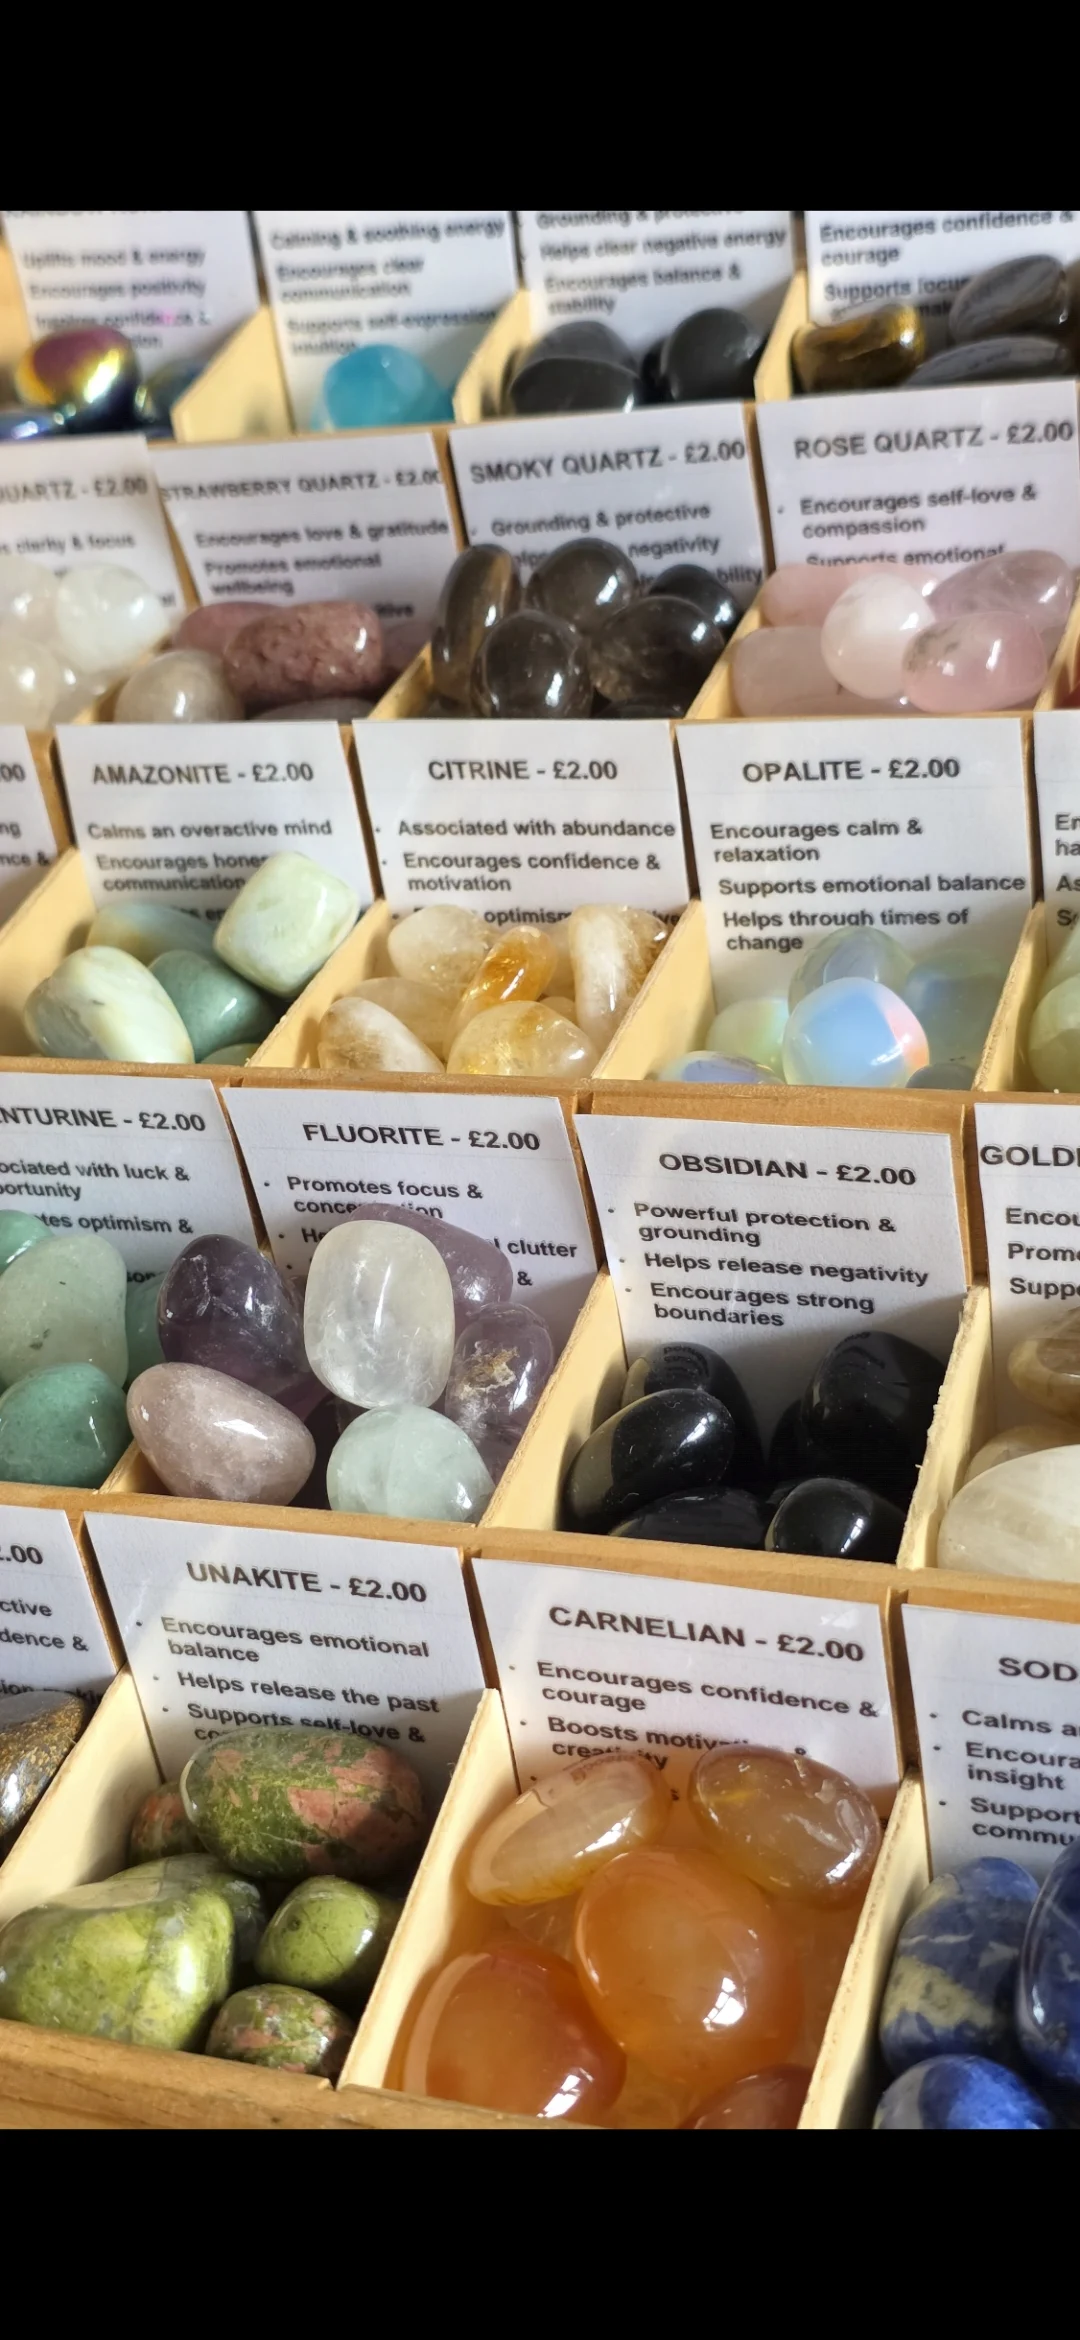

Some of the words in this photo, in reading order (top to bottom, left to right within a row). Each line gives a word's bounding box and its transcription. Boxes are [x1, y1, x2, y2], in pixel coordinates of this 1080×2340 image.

[819, 219, 935, 243] Encourages
[539, 241, 591, 262] Helps
[595, 238, 637, 257] clear
[642, 233, 718, 257] negative
[723, 228, 787, 249] energy
[821, 247, 901, 267] courage
[276, 261, 377, 282] Encourages
[545, 272, 648, 293] Encourages
[652, 264, 723, 285] balance
[728, 261, 741, 280] &
[29, 282, 126, 301] Encourages
[281, 282, 412, 302] communication
[824, 278, 911, 301] Supports
[548, 296, 616, 316] stability
[794, 435, 866, 460] ROSE
[874, 425, 984, 453] QUARTZ
[1007, 420, 1074, 445] £2.00
[470, 458, 554, 484] SMOKY
[562, 446, 663, 475] QUARTZ
[684, 440, 745, 464] £2.00
[298, 472, 379, 494] QUARTZ
[800, 491, 920, 516] Encourages
[927, 485, 1015, 508] self-love
[1021, 483, 1037, 502] &
[491, 513, 591, 537] Grounding
[596, 511, 609, 528] &
[615, 504, 710, 530] protective
[803, 517, 926, 539] compassion
[196, 529, 301, 549] Encourages
[305, 525, 343, 542] love
[350, 523, 361, 540] &
[368, 519, 448, 543] gratitude
[628, 537, 720, 559] negativity
[205, 559, 289, 577] Promotes
[295, 553, 382, 573] emotional
[211, 579, 294, 597] wellbeing
[92, 763, 232, 786] AMAZONITE
[252, 763, 314, 784] £2.00
[428, 760, 530, 781] CITRINE
[553, 760, 618, 781] £2.00
[742, 760, 864, 783] OPALITE
[888, 758, 961, 780] £2.00
[87, 821, 147, 840] Calms
[153, 823, 175, 838] an
[180, 819, 279, 838] overactive
[284, 818, 333, 837] mind
[398, 819, 508, 837] Associated
[514, 818, 556, 837] with
[562, 819, 676, 838] abundance
[710, 822, 840, 842] Encourages
[846, 820, 899, 837] calm
[907, 819, 923, 836] &
[97, 853, 209, 872] Encourages
[403, 853, 522, 873] Encourages
[528, 853, 640, 871] confidence
[646, 854, 661, 871] &
[714, 846, 820, 863] relaxation
[103, 876, 246, 892] communication
[408, 875, 512, 892] motivation
[719, 878, 816, 899] Supports
[822, 875, 931, 893] emotional
[938, 874, 1026, 892] balance
[723, 911, 783, 932] Helps
[789, 909, 874, 927] through
[881, 908, 940, 926] times
[947, 907, 969, 925] of
[726, 935, 804, 954] change
[0, 1107, 117, 1128] NTURINE
[139, 1112, 207, 1132] £2.00
[302, 1123, 444, 1147] FLUORITE
[468, 1130, 541, 1151] £2.00
[78, 1162, 120, 1179] with
[124, 1164, 169, 1181] luck
[175, 1166, 190, 1181] &
[659, 1153, 808, 1180] OBSIDIAN
[836, 1164, 916, 1186] £2.00
[286, 1176, 392, 1195] Promotes
[398, 1179, 460, 1198] focus
[466, 1183, 483, 1199] &
[78, 1214, 172, 1233] optimism
[178, 1219, 194, 1234] &
[634, 1202, 739, 1223] Powerful
[745, 1210, 870, 1231] protection
[878, 1217, 896, 1232] &
[507, 1239, 578, 1258] clutter
[639, 1225, 761, 1248] grounding
[517, 1270, 533, 1286] &
[644, 1252, 711, 1273] Helps
[718, 1257, 803, 1276] release
[809, 1264, 929, 1288] negativity
[650, 1281, 789, 1306] Encourages
[796, 1291, 876, 1315] strong
[654, 1303, 785, 1327] boundaries
[186, 1560, 322, 1593] UNAKITE
[348, 1577, 428, 1603] £2.00
[73, 1636, 89, 1651] &
[161, 1615, 303, 1646] Encourages
[310, 1632, 430, 1657] emotional
[548, 1604, 746, 1648] CARNELIAN
[777, 1633, 865, 1662] £2.00
[168, 1638, 260, 1663] balance
[178, 1670, 245, 1695] Helps
[251, 1678, 337, 1702] release
[342, 1687, 381, 1706] the
[388, 1695, 440, 1714] past
[536, 1660, 693, 1695] Encourages
[700, 1682, 851, 1715] confidence
[858, 1701, 880, 1718] &
[542, 1685, 647, 1713] courage
[187, 1702, 295, 1727] Supports
[300, 1717, 401, 1741] self-love
[408, 1726, 427, 1743] &
[547, 1715, 638, 1742] Boosts
[962, 1709, 1052, 1734] Calms
[967, 1763, 1066, 1791] insight
